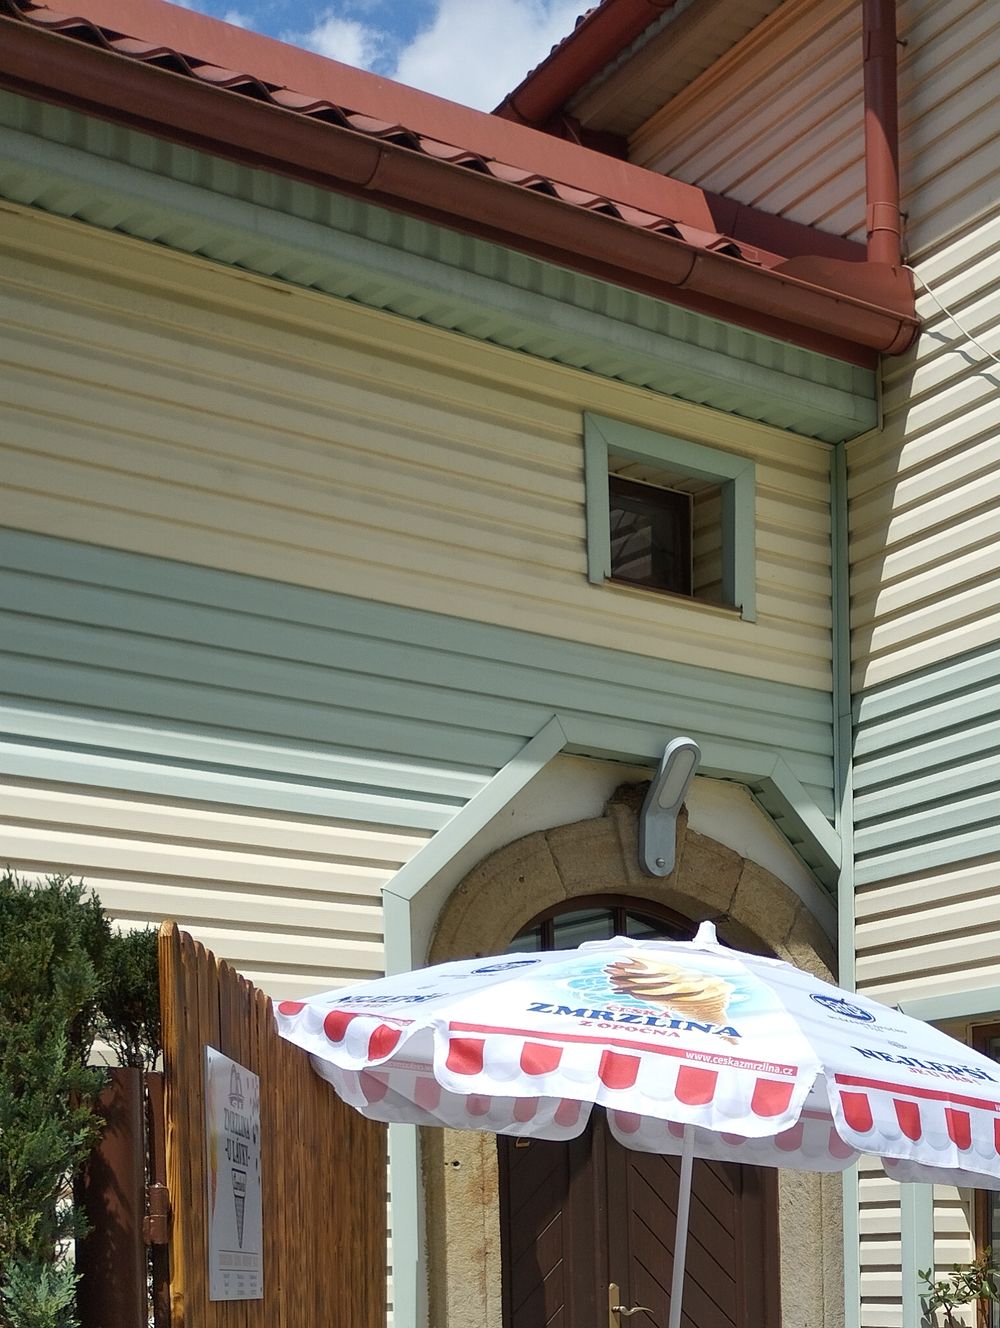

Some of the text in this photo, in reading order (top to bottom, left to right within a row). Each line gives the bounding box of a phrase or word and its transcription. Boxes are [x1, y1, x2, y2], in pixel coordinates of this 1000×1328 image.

[526, 1002, 742, 1038] ZMRZLINA
[597, 1022, 681, 1038] OPOČNA
[685, 1051, 794, 1076] www.ceskazmrzlina.cz
[850, 1045, 999, 1083] NEJLEPŠÍ
